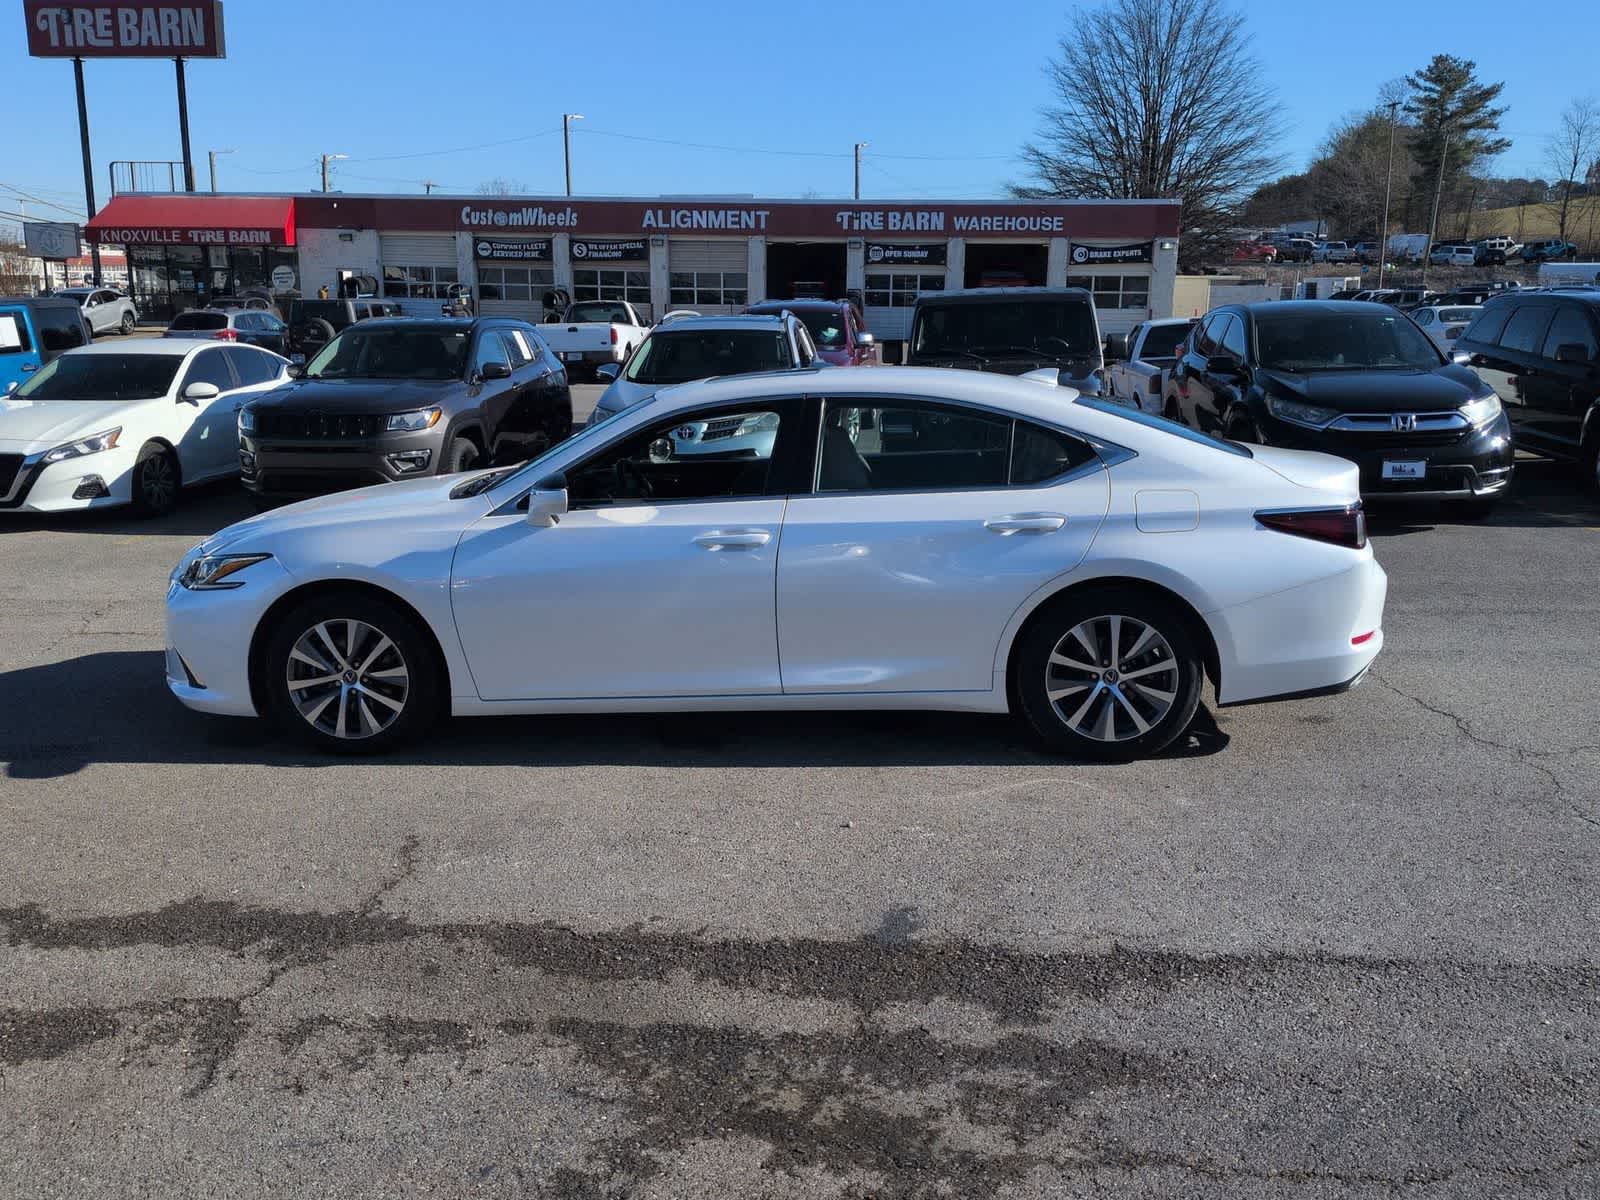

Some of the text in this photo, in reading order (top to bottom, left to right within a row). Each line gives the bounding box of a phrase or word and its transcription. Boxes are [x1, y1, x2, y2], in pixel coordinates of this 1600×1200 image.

[118, 7, 206, 47] BARN
[642, 209, 770, 229] ALIGNMENT
[888, 211, 945, 231] BARN
[953, 215, 1064, 232] WAREHOUSE
[99, 229, 181, 243] KNOXVILLE
[228, 230, 271, 243] BARN
[619, 241, 644, 250] SPECIAL
[885, 250, 929, 258] OPEN SUNDAY
[1089, 248, 1142, 258] BRAKE EXPERTS
